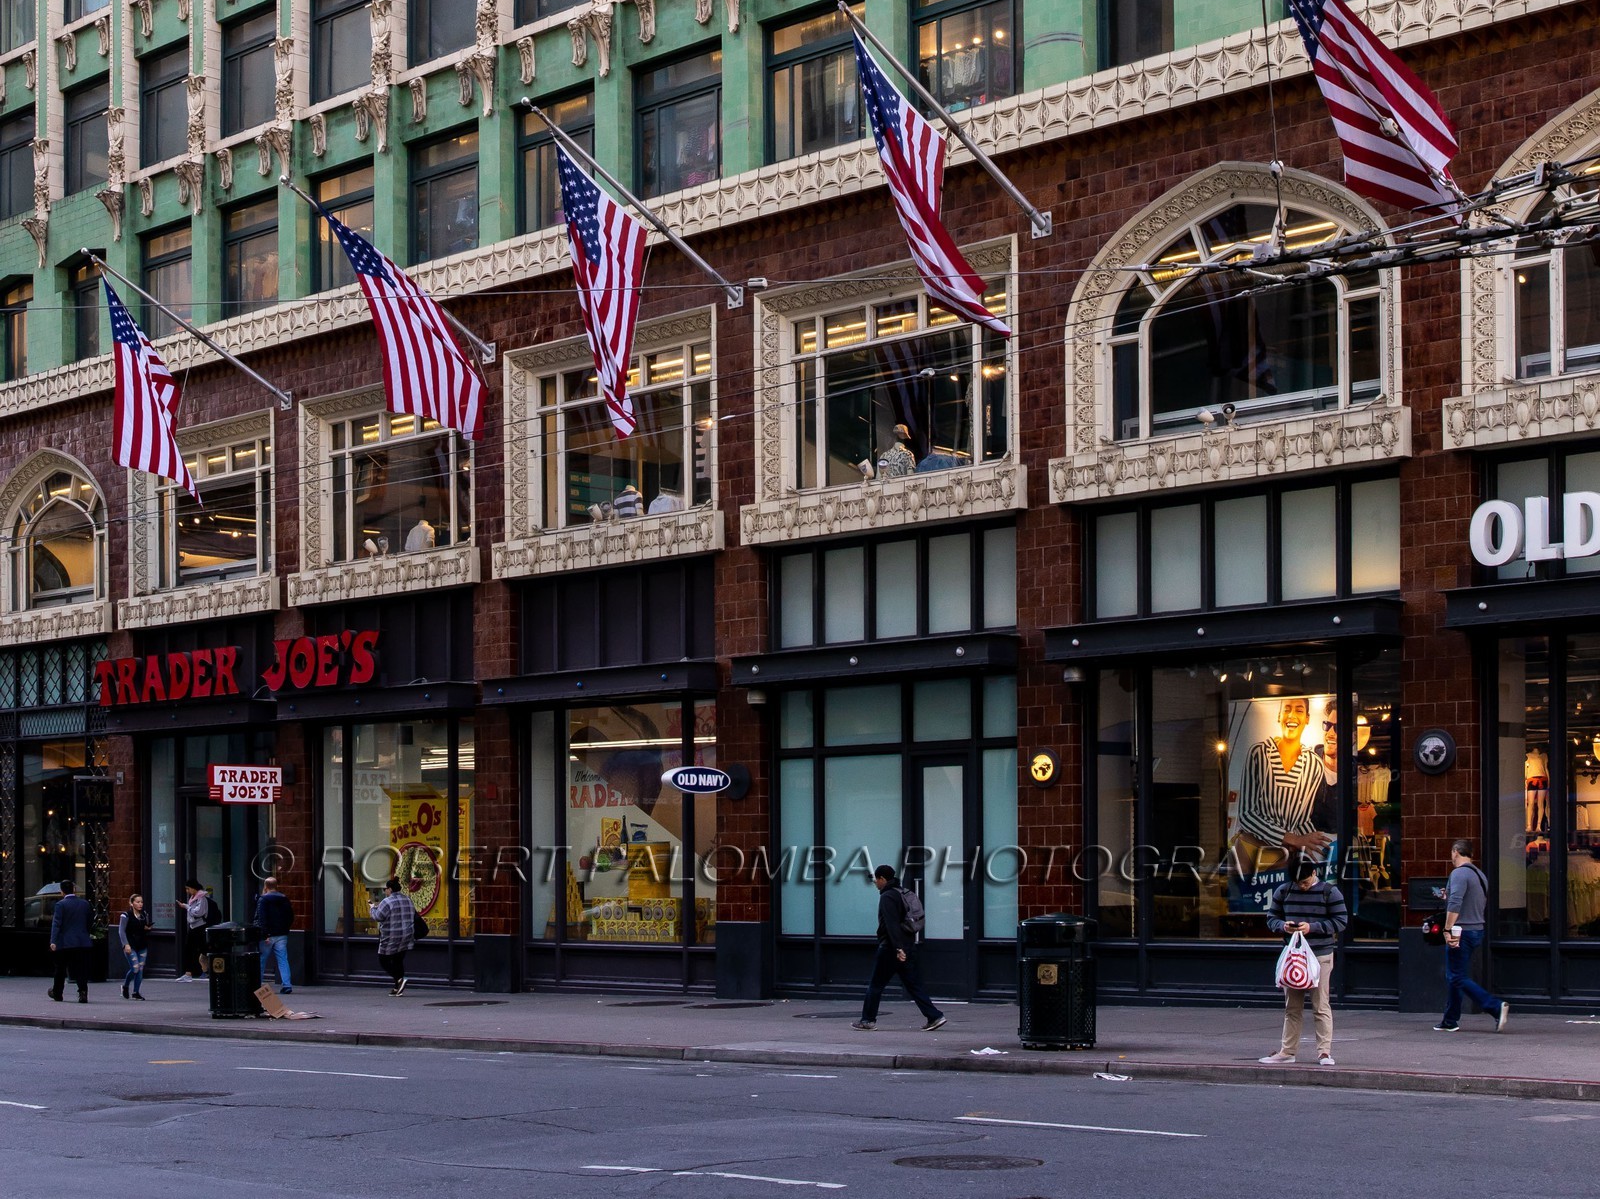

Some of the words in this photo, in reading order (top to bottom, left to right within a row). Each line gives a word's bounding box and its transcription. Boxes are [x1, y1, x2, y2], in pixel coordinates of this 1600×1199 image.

[1469, 491, 1600, 566] OLD
[94, 646, 240, 706] TRADER
[260, 629, 380, 691] JOE'S
[218, 769, 278, 784] TRADER
[574, 769, 602, 782] Welcom
[677, 773, 697, 786] OLD
[698, 774, 724, 787] NAVY
[228, 785, 270, 799] JOE'S
[391, 820, 418, 844] JOE'S
[1251, 872, 1285, 886] SWIM
